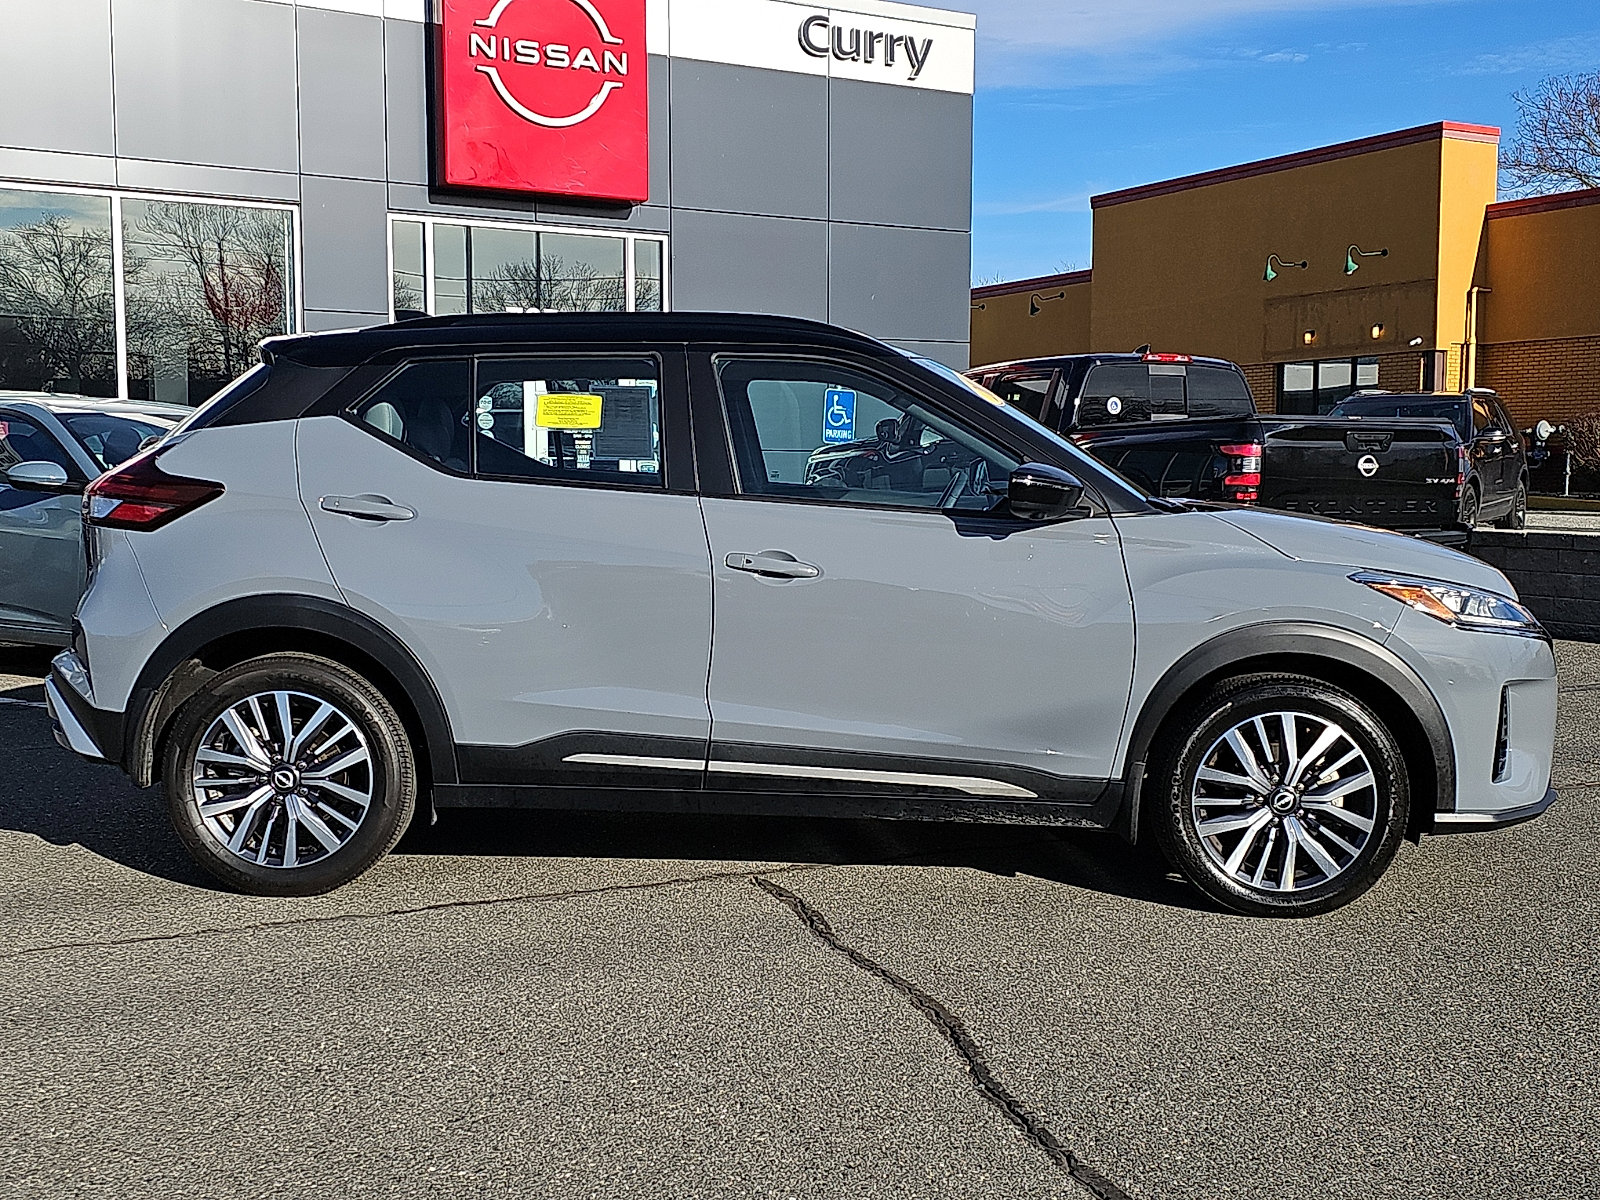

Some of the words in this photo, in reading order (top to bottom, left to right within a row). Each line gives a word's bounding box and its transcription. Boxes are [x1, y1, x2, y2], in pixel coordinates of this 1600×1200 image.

[469, 32, 629, 76] NISSAN
[798, 14, 934, 81] Curry
[825, 428, 852, 440] PARKING
[1285, 499, 1439, 515] FRONTIER
